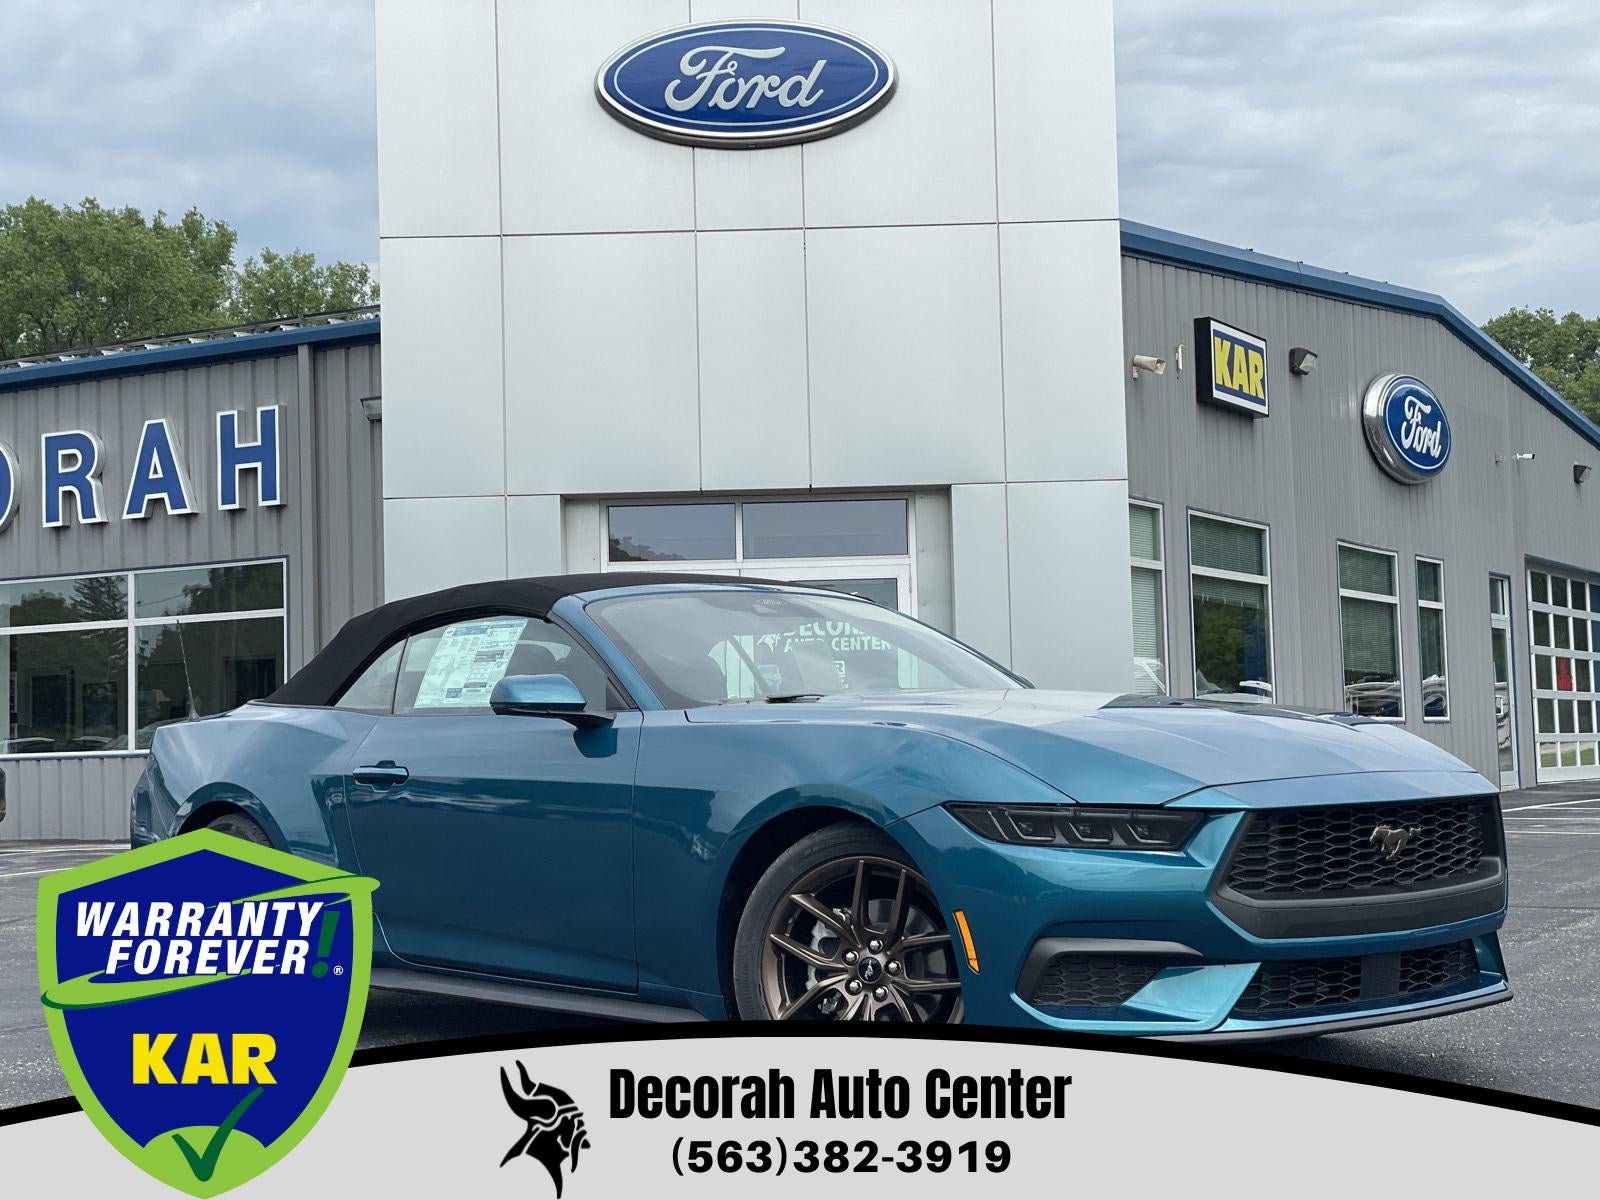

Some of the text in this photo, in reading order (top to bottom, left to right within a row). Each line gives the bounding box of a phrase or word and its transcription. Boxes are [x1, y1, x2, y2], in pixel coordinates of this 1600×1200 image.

[664, 46, 827, 111] Ford
[1214, 336, 1265, 400] KAR
[1401, 395, 1441, 459] Ford
[0, 404, 281, 530] RAH
[831, 635, 892, 652] CENTER
